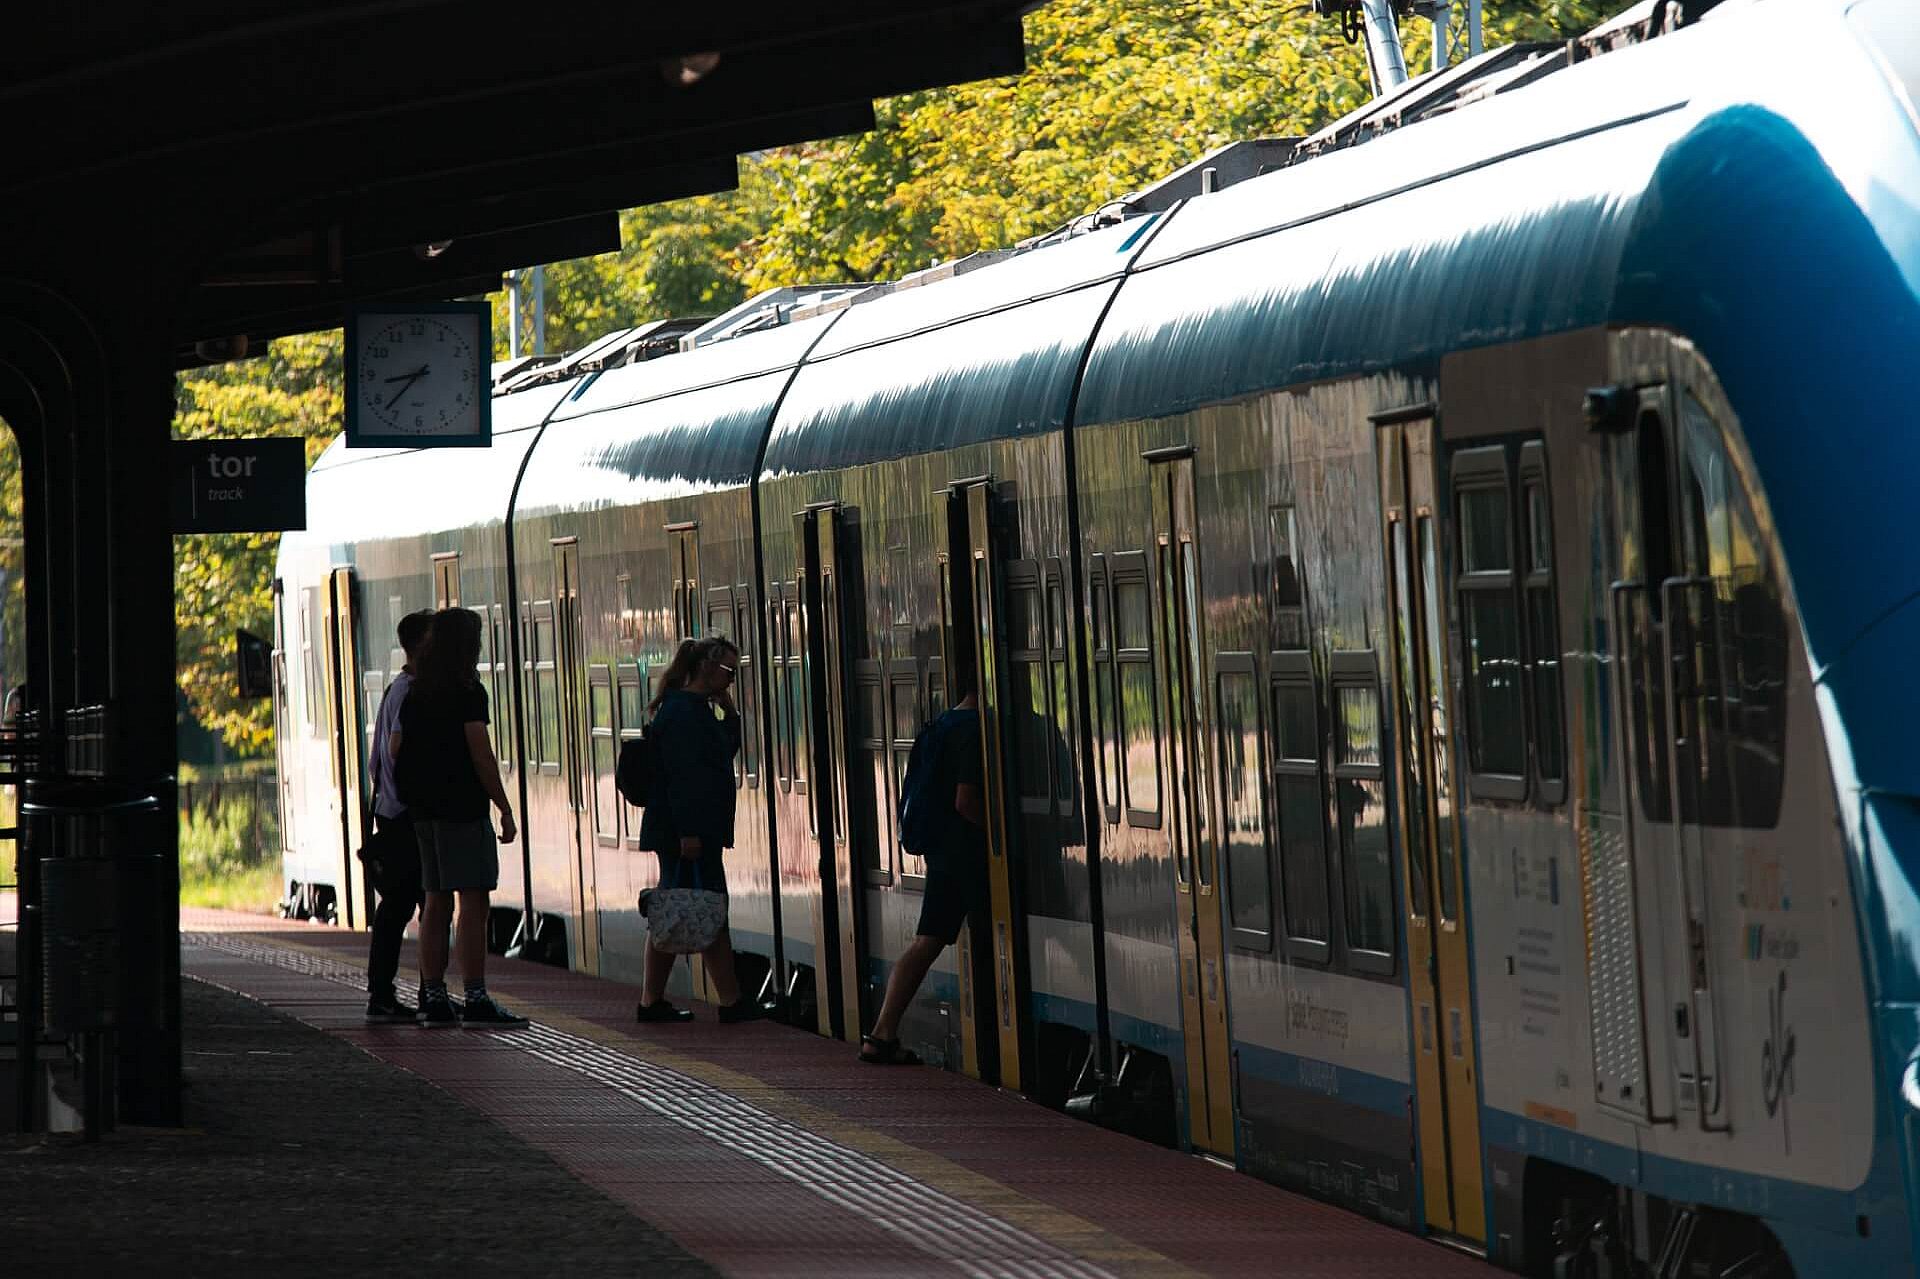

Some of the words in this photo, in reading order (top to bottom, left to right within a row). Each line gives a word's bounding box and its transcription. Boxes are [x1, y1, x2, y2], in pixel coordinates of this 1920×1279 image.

[409, 324, 425, 336] 12
[436, 330, 445, 342] 1
[389, 331, 403, 343] 11
[373, 347, 389, 358] 10
[367, 369, 376, 381] 9
[391, 410, 400, 421] 7
[415, 415, 424, 427] 6
[208, 452, 257, 478] tor
[208, 486, 245, 501] track
